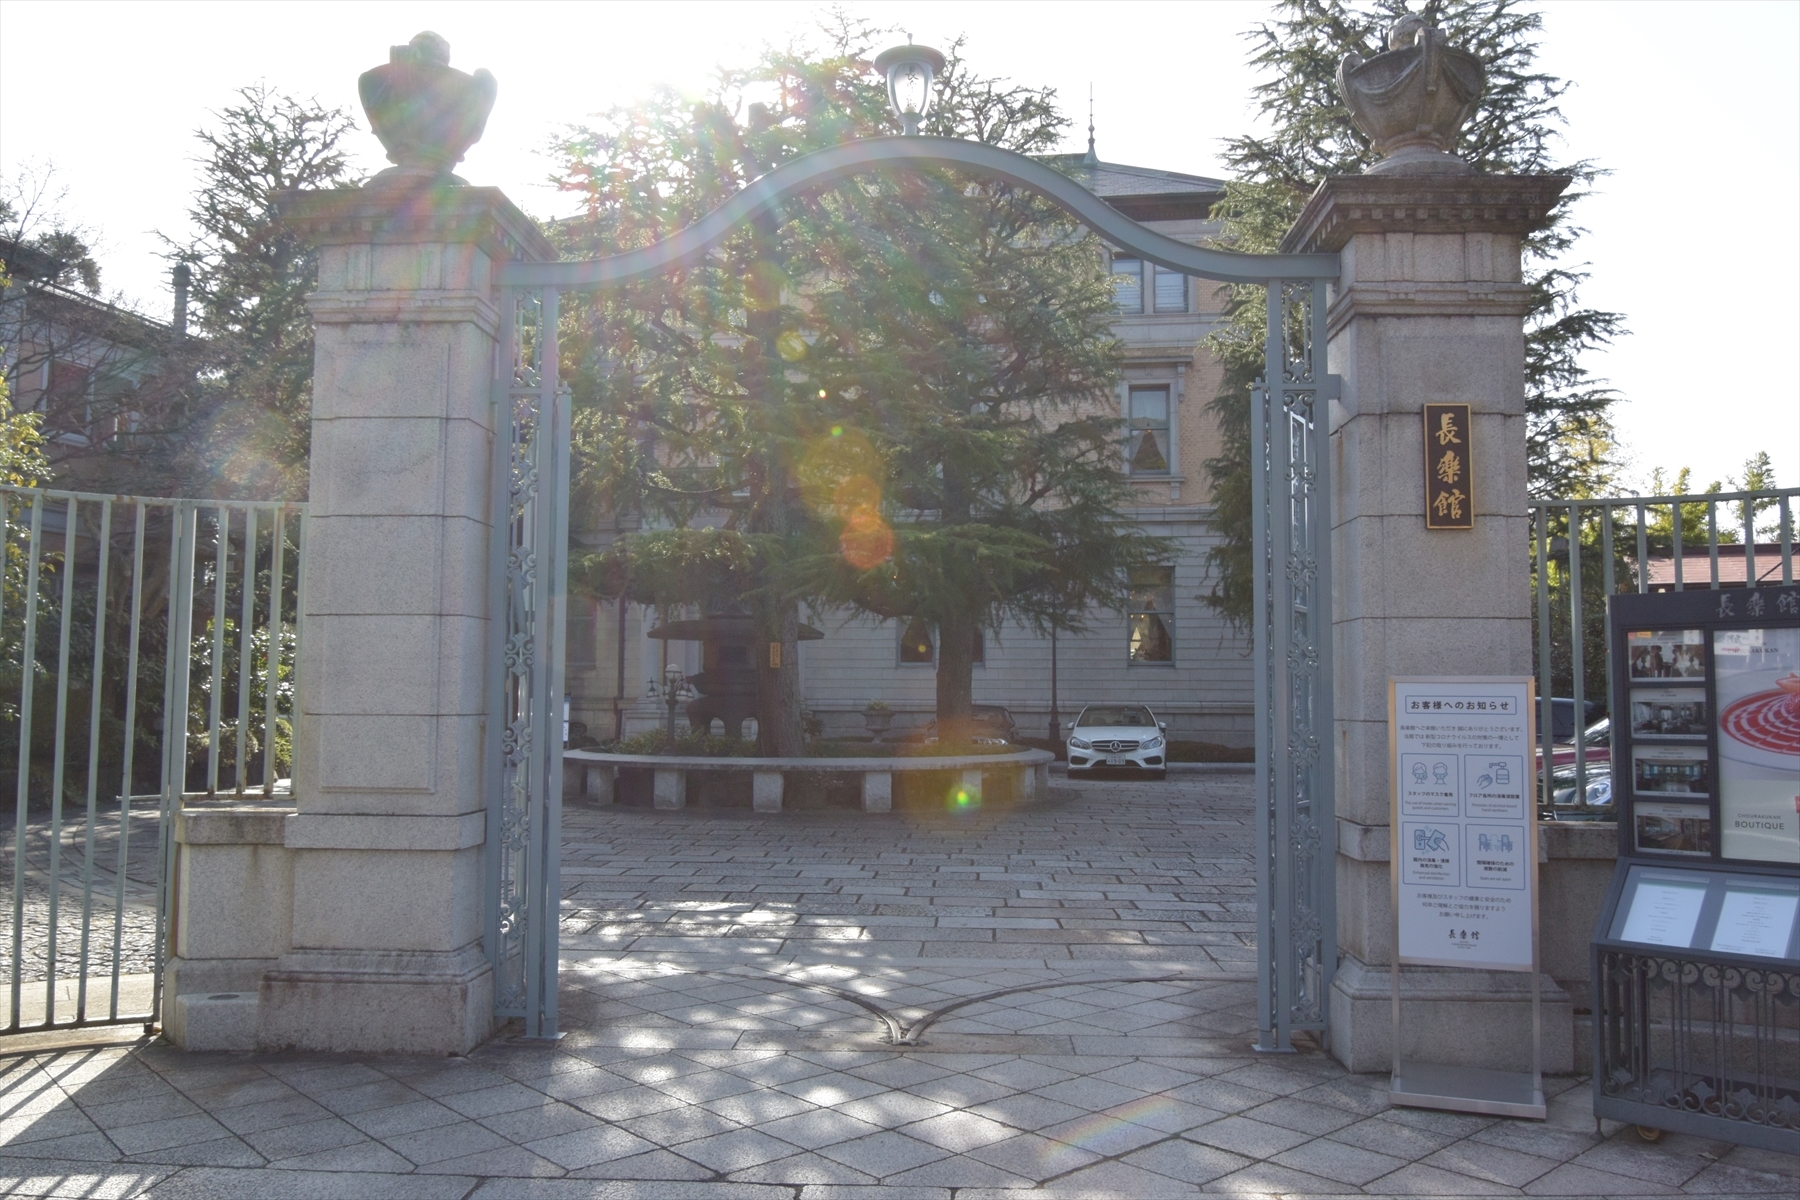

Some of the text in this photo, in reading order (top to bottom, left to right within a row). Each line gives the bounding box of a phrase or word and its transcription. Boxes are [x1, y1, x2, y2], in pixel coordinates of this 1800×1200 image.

[1410, 700, 1510, 711] お客様へのお知らせ
[1734, 820, 1785, 830] BOUTIQUE
